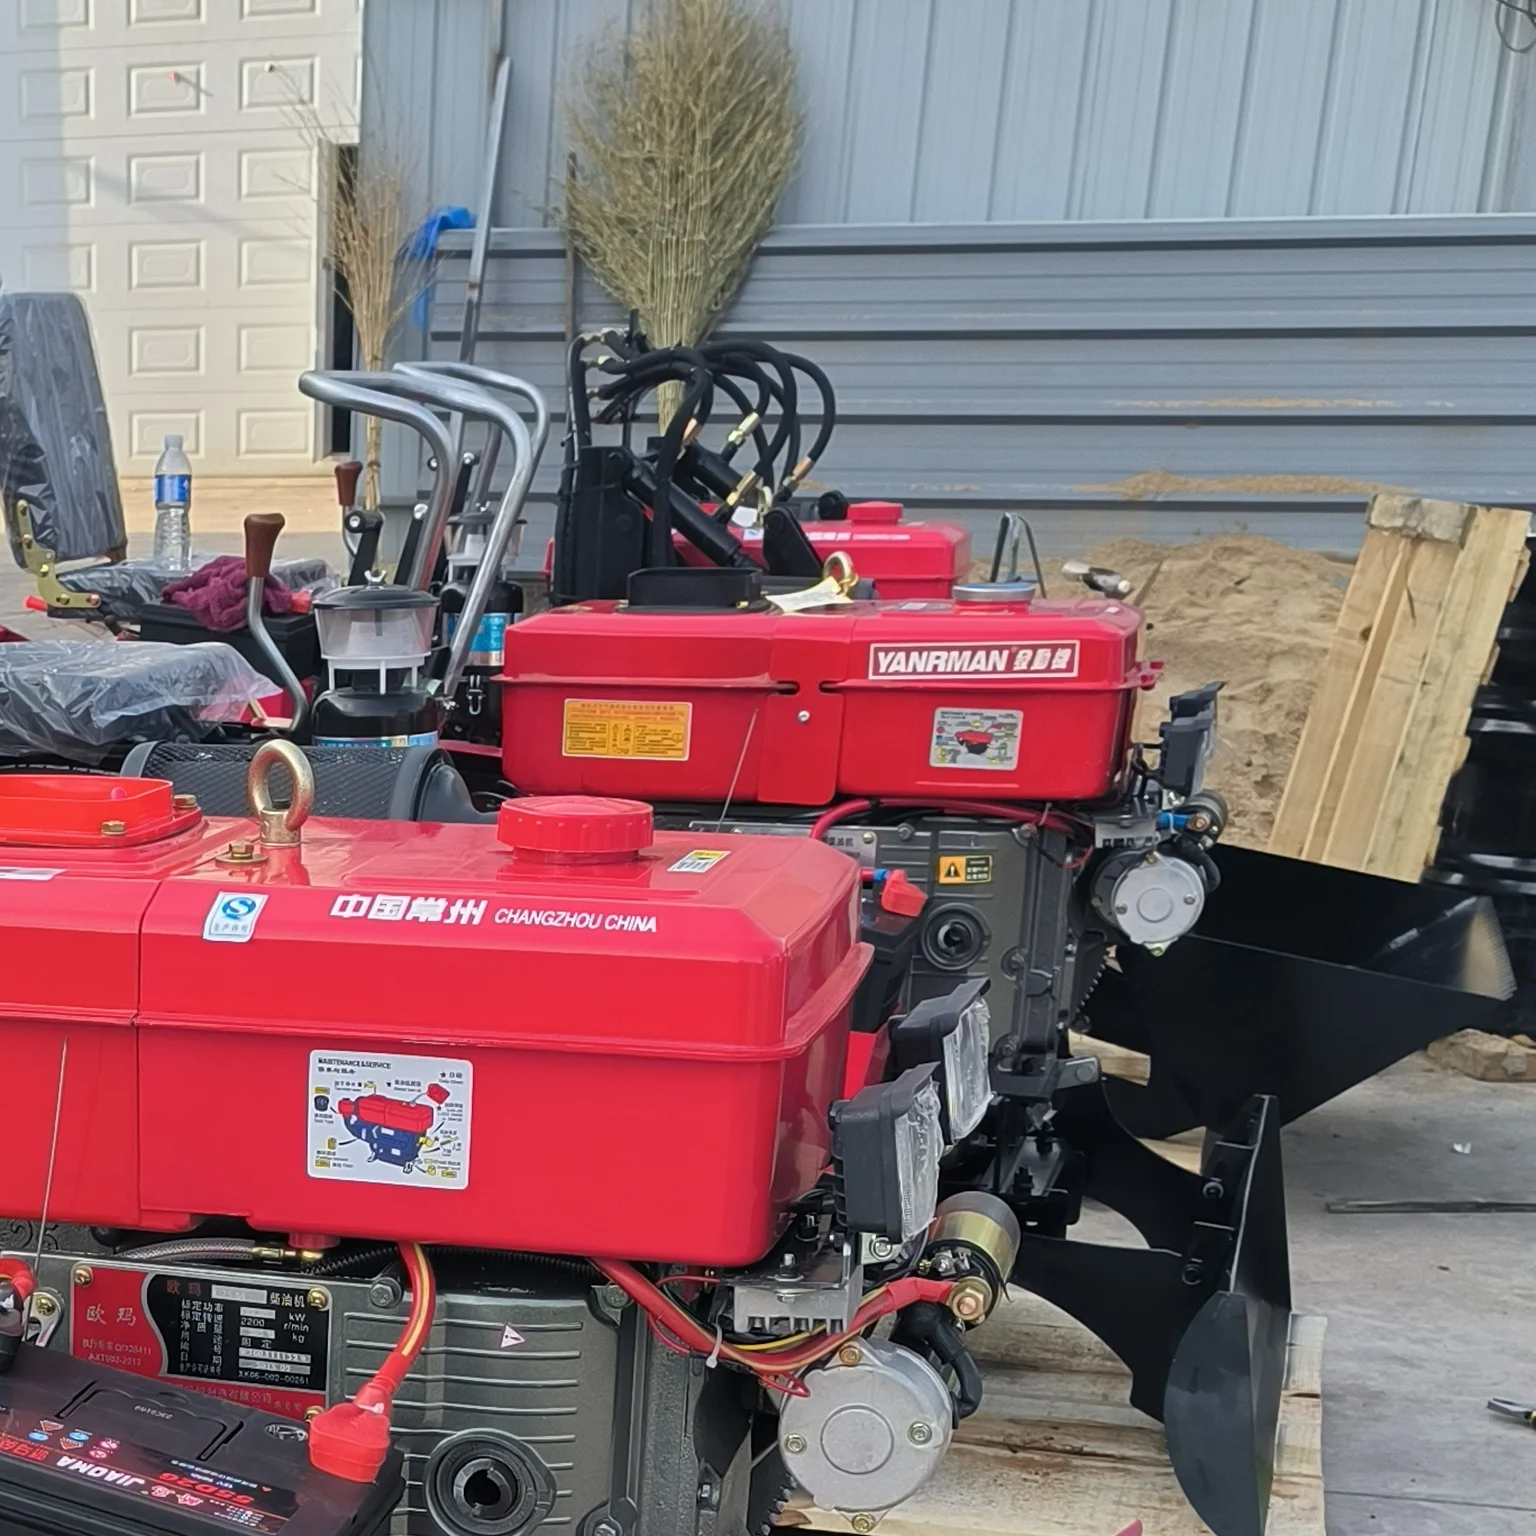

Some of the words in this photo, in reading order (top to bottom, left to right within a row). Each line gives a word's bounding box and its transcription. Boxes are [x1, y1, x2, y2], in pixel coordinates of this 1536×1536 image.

[877, 648, 1009, 673] YANRMAN
[329, 893, 488, 925] 中国常州
[493, 907, 602, 929] CHANGZHOU
[604, 914, 658, 933] CHINA
[86, 1303, 137, 1327] 欧玛
[240, 1317, 265, 1328] 2200
[283, 1321, 310, 1333] r/min
[288, 1313, 306, 1322] kW
[292, 1332, 306, 1344] kg
[56, 1455, 146, 1488] JIAOMA
